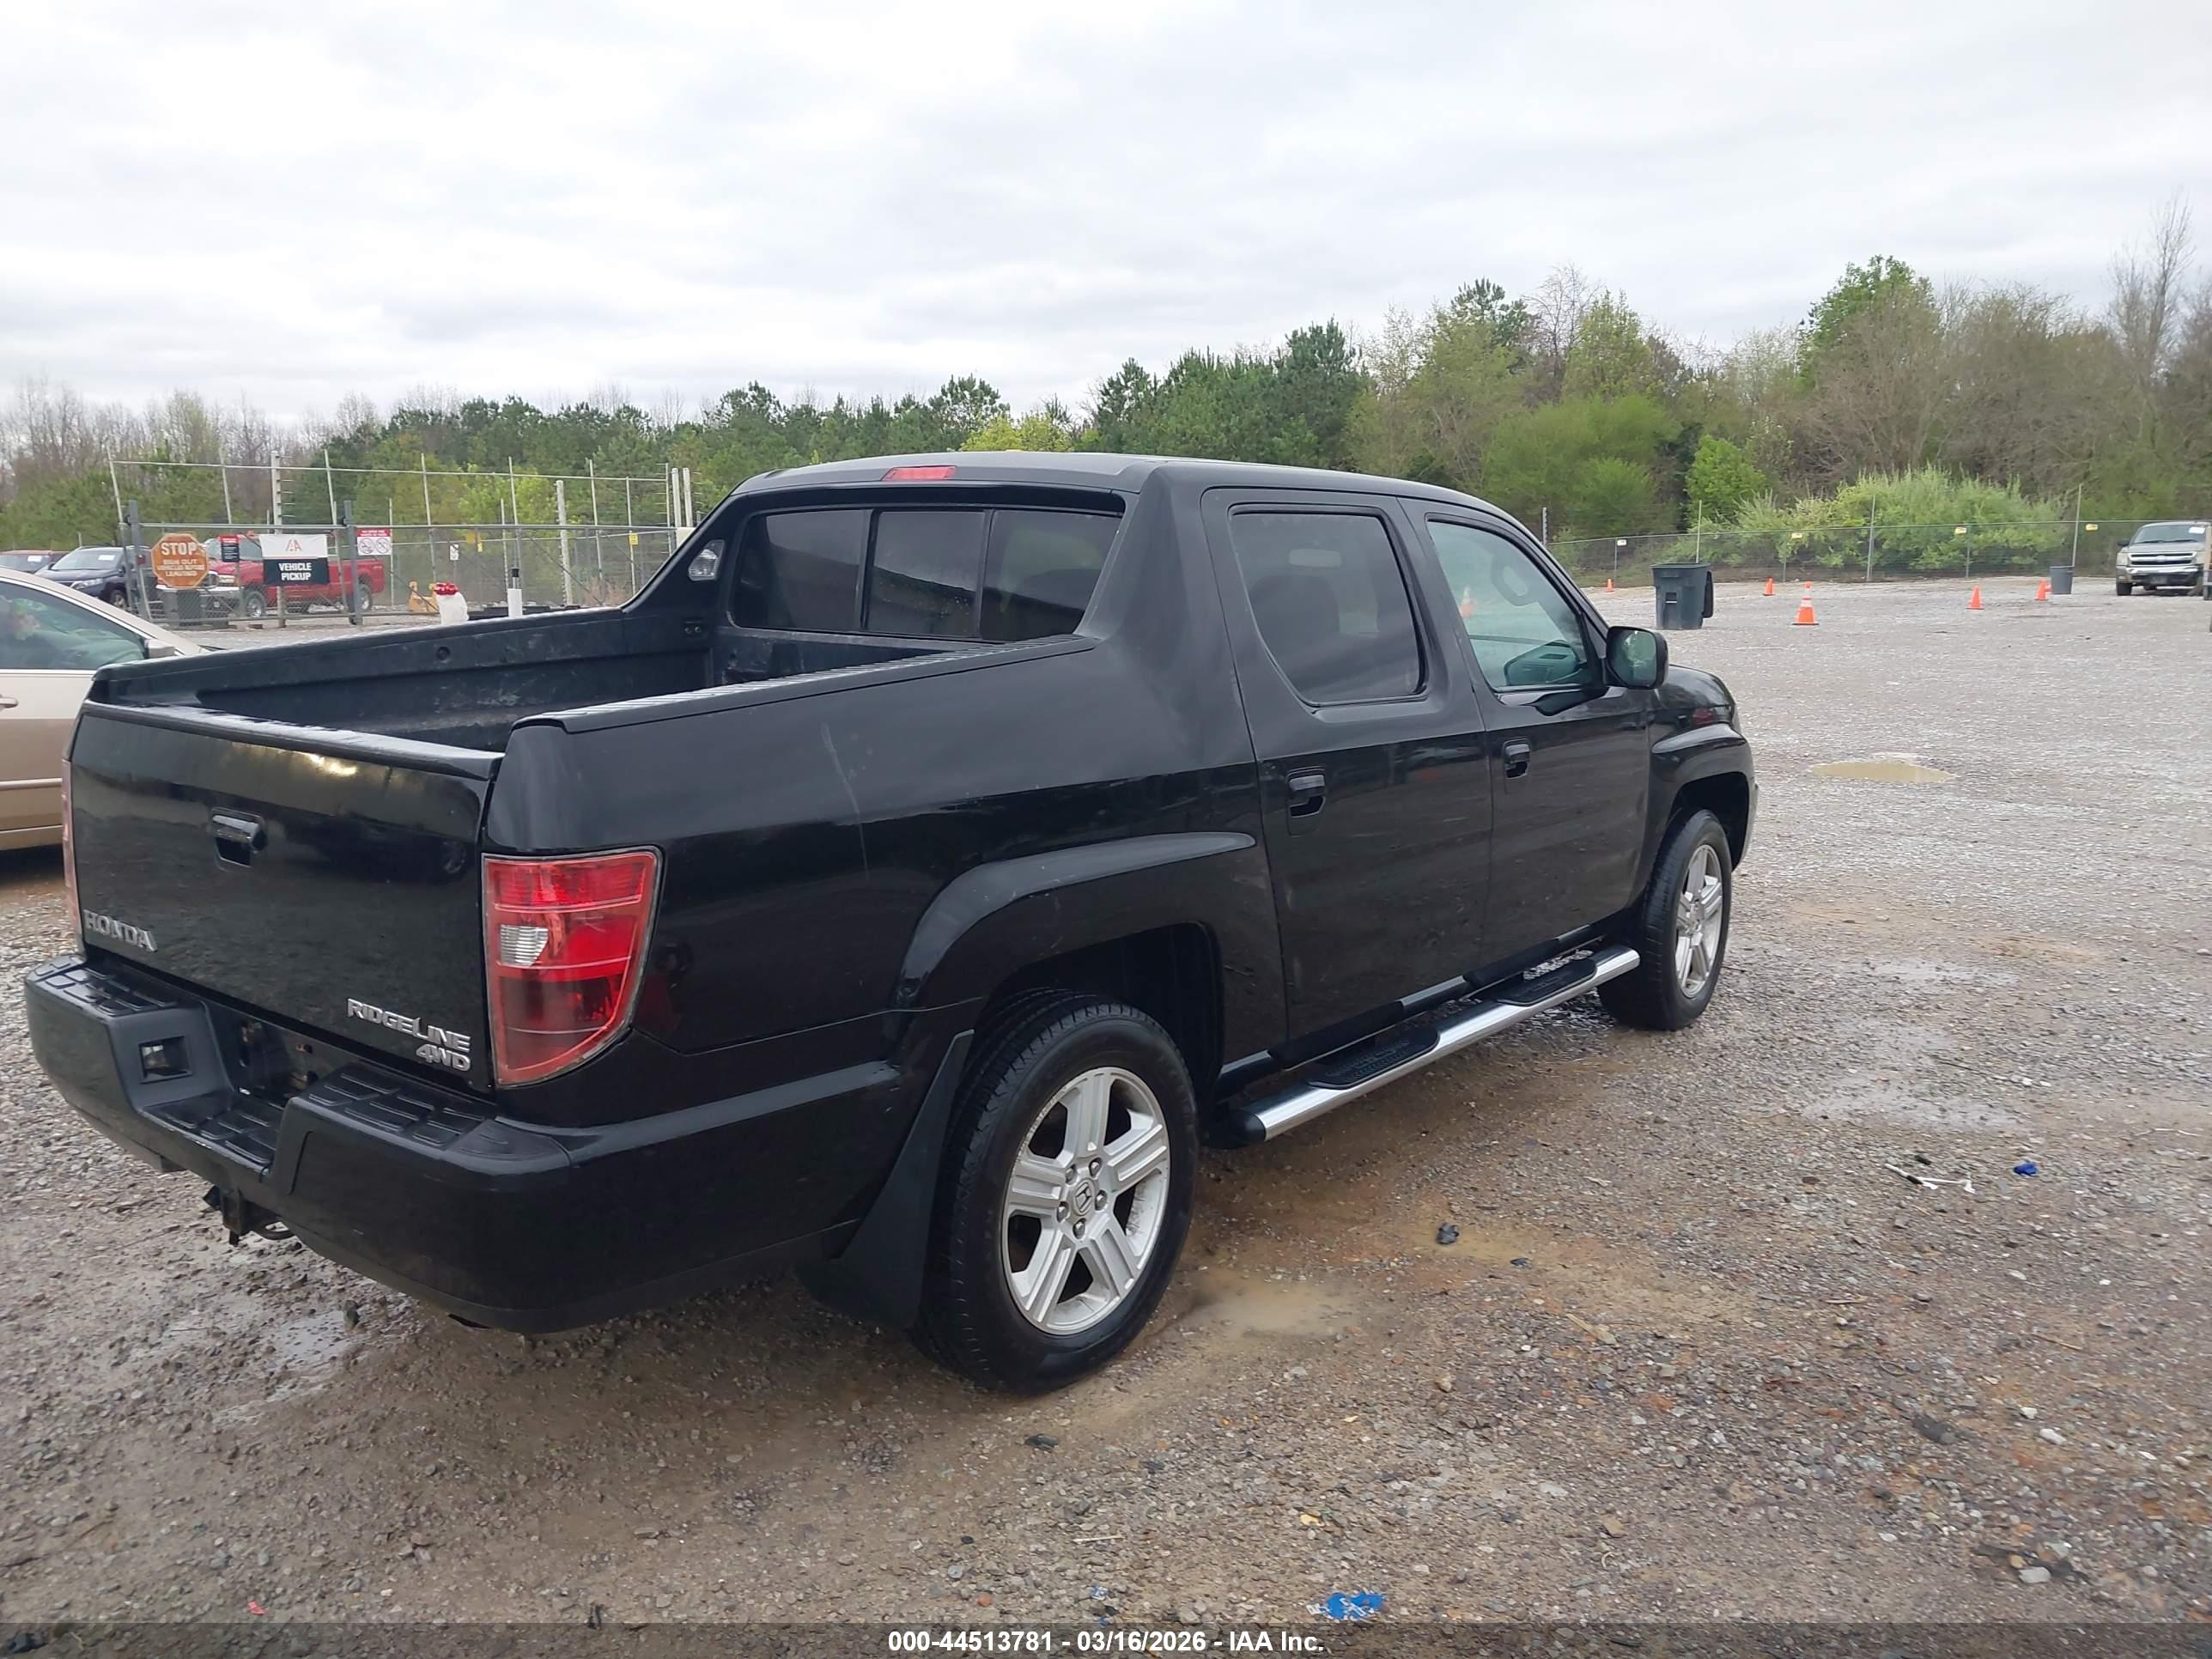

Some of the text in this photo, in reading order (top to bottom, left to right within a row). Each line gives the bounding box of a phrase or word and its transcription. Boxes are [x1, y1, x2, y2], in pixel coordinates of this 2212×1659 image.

[161, 542, 197, 556] STOP
[278, 562, 312, 571] VEHICLE
[281, 572, 312, 580] PICKUP
[82, 909, 157, 952] HONDA
[347, 998, 471, 1053] RIDGELINE
[416, 1043, 471, 1072] 4WD
